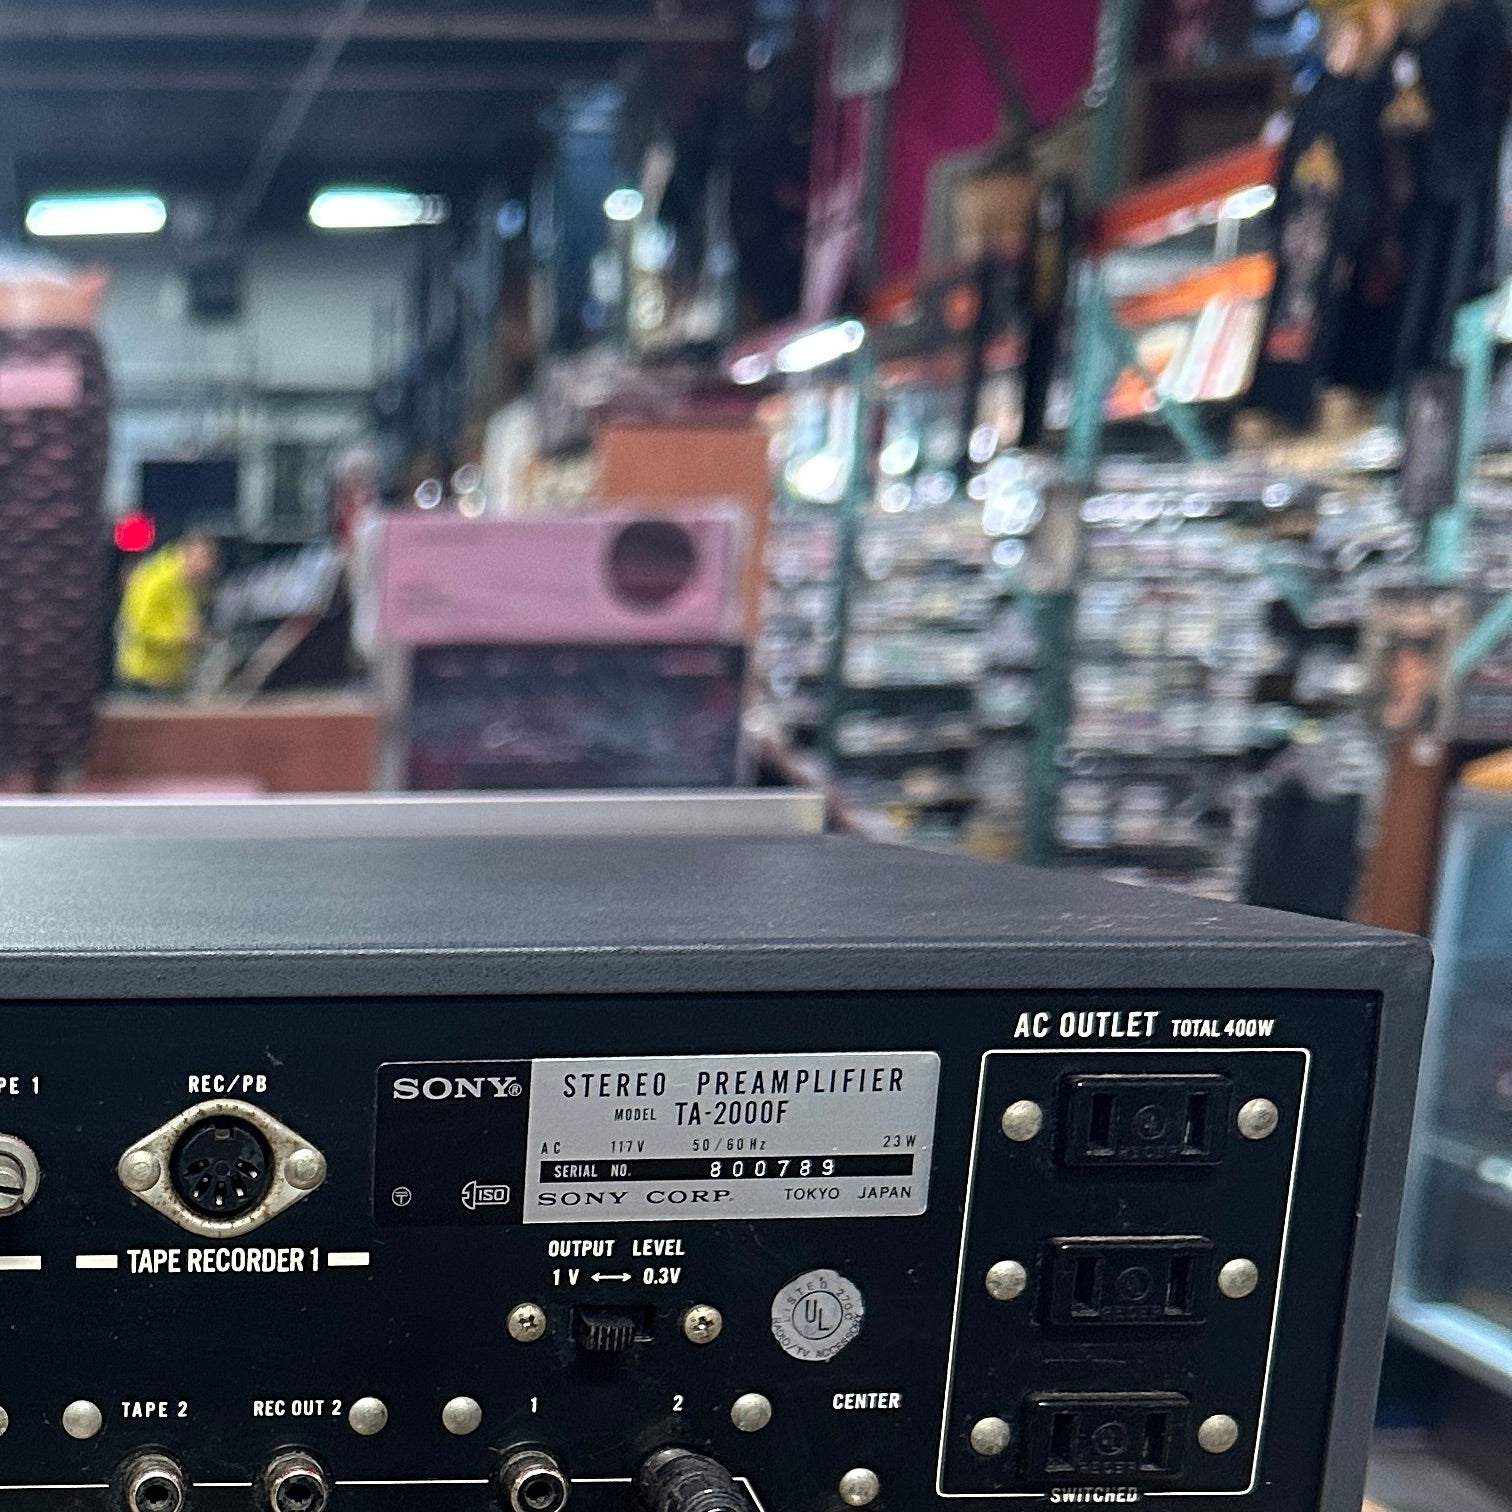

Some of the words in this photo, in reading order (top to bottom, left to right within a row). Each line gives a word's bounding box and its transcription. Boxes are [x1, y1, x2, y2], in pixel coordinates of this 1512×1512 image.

[1013, 1012, 1049, 1038] AC
[1059, 1011, 1159, 1038] OUTLET
[1171, 1018, 1221, 1038] TOTAL
[1223, 1018, 1275, 1038] 400W
[31, 1076, 39, 1095] 1
[188, 1074, 267, 1094] REC/PB
[563, 1072, 666, 1098] STEREO
[696, 1067, 903, 1096] PREAMPLIFIER
[614, 1108, 657, 1121] MODEL
[674, 1100, 789, 1126] TA-2000F
[540, 1141, 561, 1155] AC
[611, 1140, 645, 1153] 117V
[882, 1134, 917, 1148] 23W
[553, 1164, 598, 1178] SERIAL
[610, 1163, 632, 1178] NO.
[709, 1159, 836, 1179] 800789
[478, 1188, 505, 1202] ISO
[537, 1191, 629, 1206] SONY
[784, 1187, 840, 1201] TOKYO
[857, 1186, 912, 1200] JAPAN
[548, 1239, 616, 1258] OUTPUT
[632, 1238, 685, 1257] LEVEL
[126, 1248, 181, 1274] TAPE
[187, 1247, 305, 1273] RECORDER
[309, 1247, 319, 1272] 1
[642, 1267, 682, 1285] 0.3V
[121, 1401, 169, 1418] TAPE
[177, 1400, 188, 1418] 2
[253, 1399, 286, 1417] REC
[291, 1399, 325, 1416] OUT
[331, 1399, 342, 1416] 2
[530, 1396, 538, 1413] 1
[672, 1394, 684, 1412] 2
[832, 1392, 901, 1410] CENTER
[1049, 1486, 1139, 1504] SWITCHED
